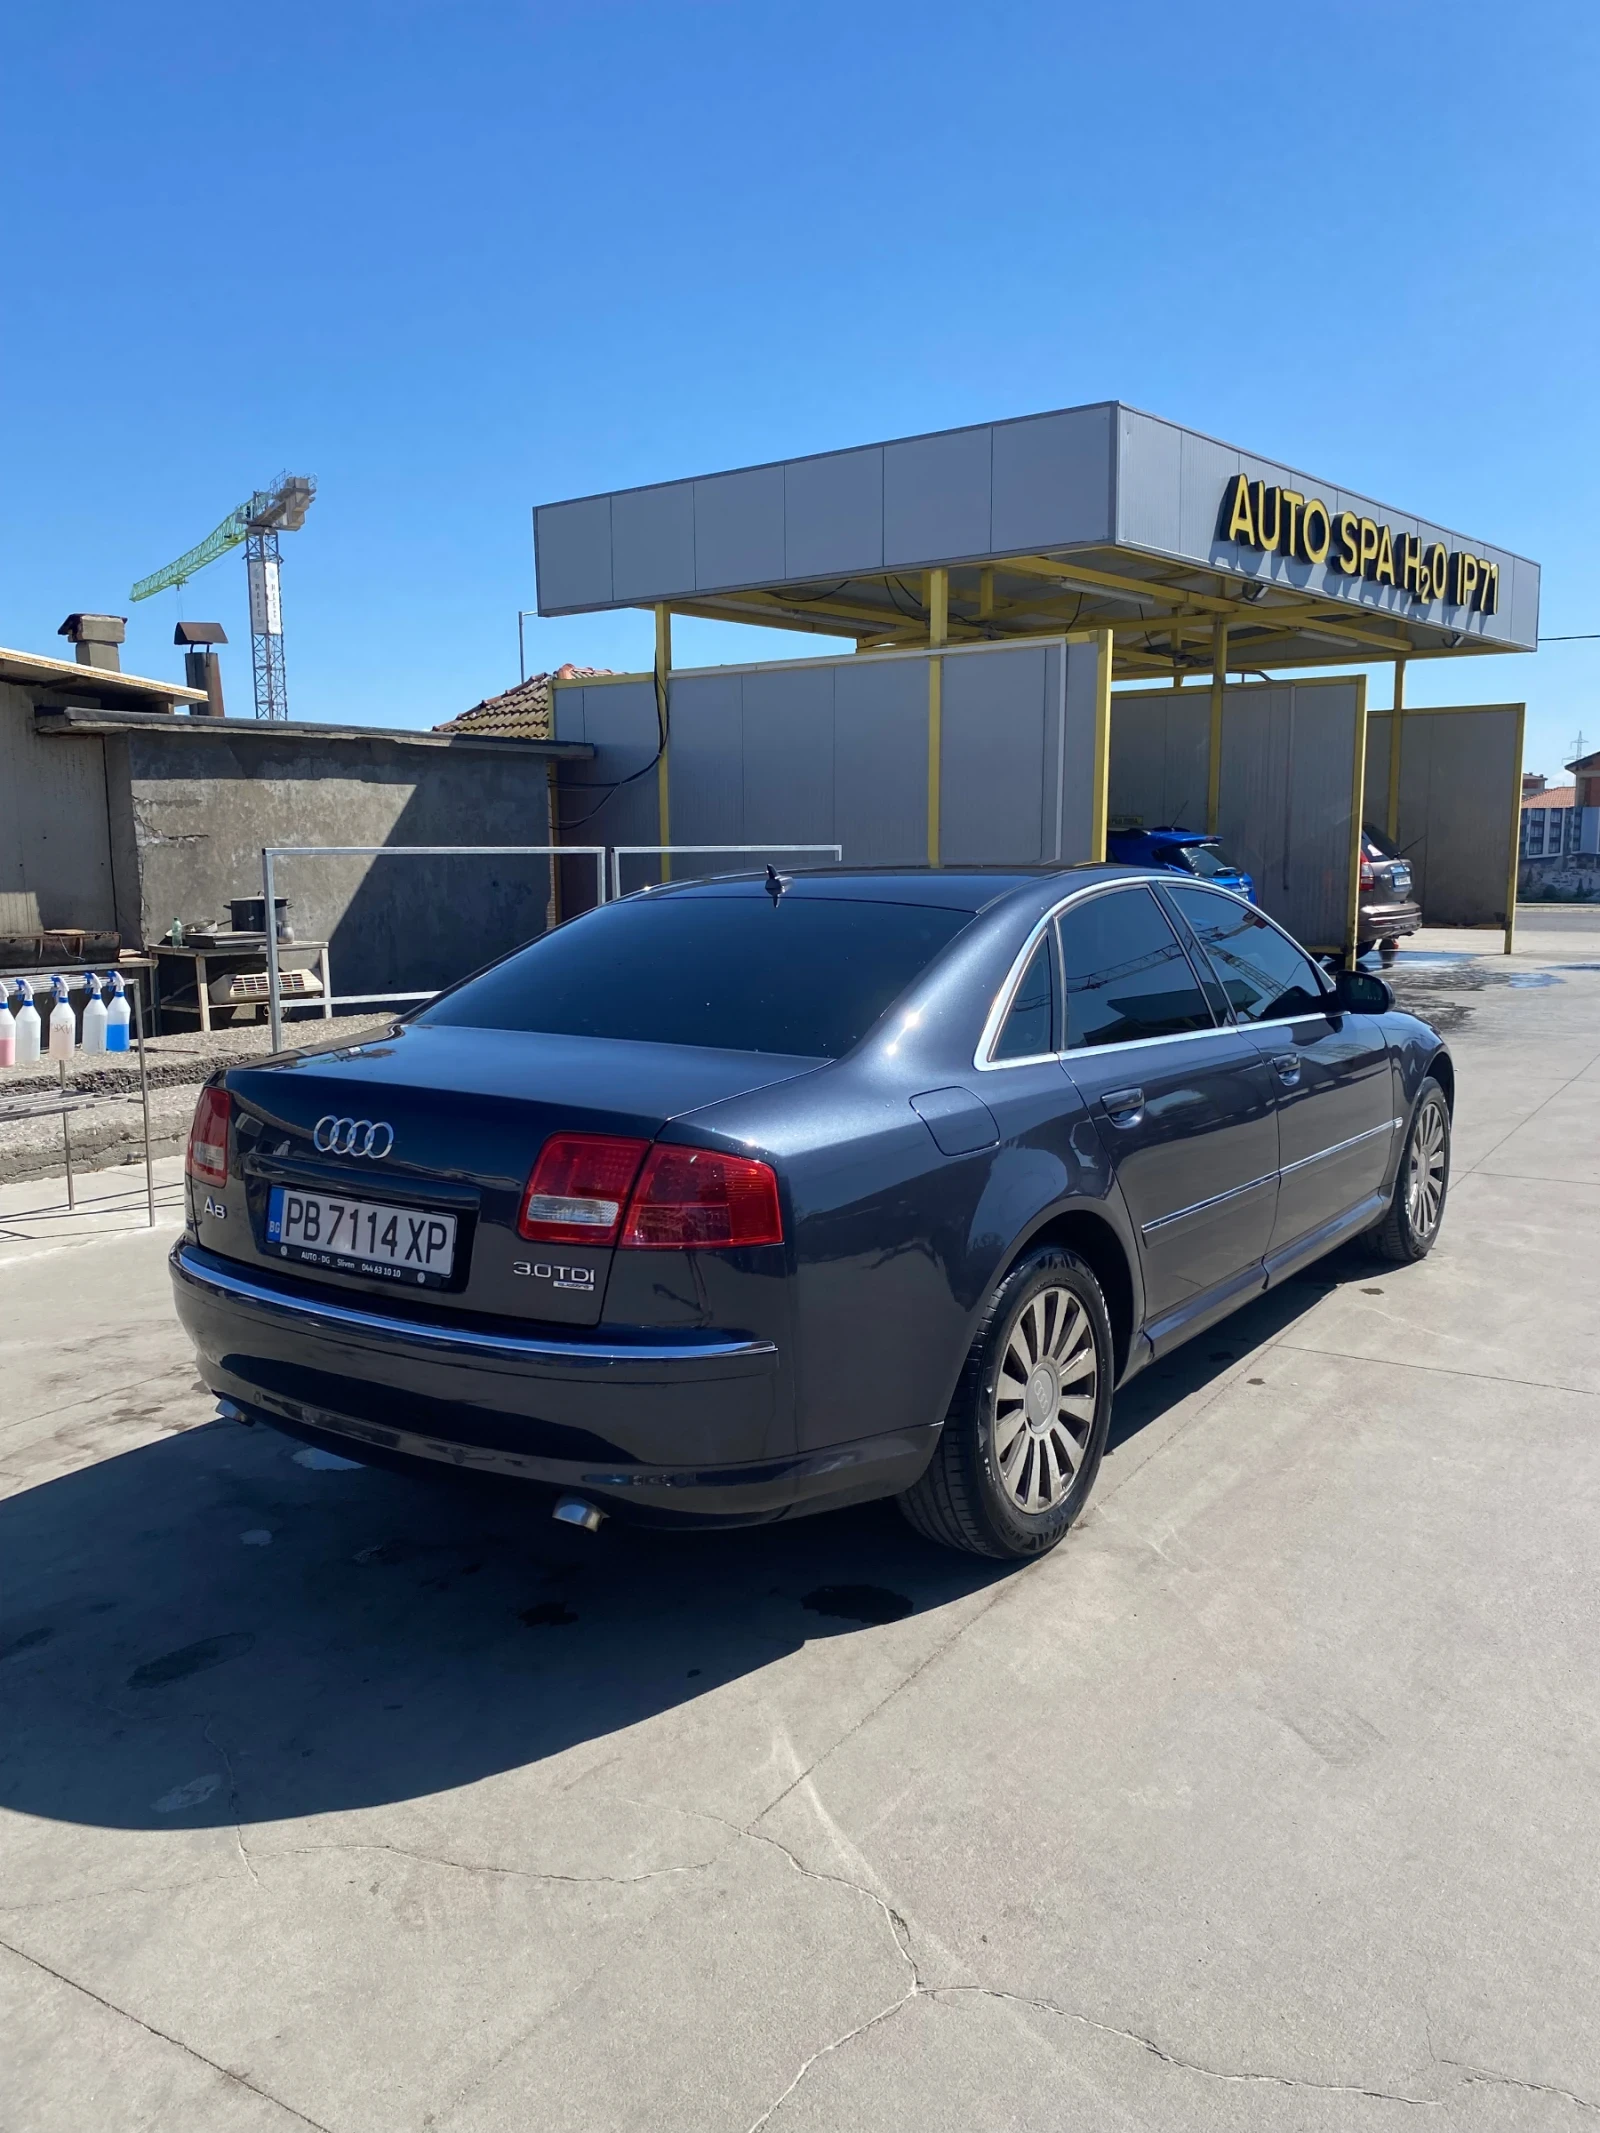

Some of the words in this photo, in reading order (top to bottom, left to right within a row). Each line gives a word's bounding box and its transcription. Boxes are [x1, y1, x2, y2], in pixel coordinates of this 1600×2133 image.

[1222, 473, 1331, 565] AUTO
[1335, 511, 1395, 586] SPA
[204, 1196, 226, 1219] A8
[269, 1221, 280, 1233] BG
